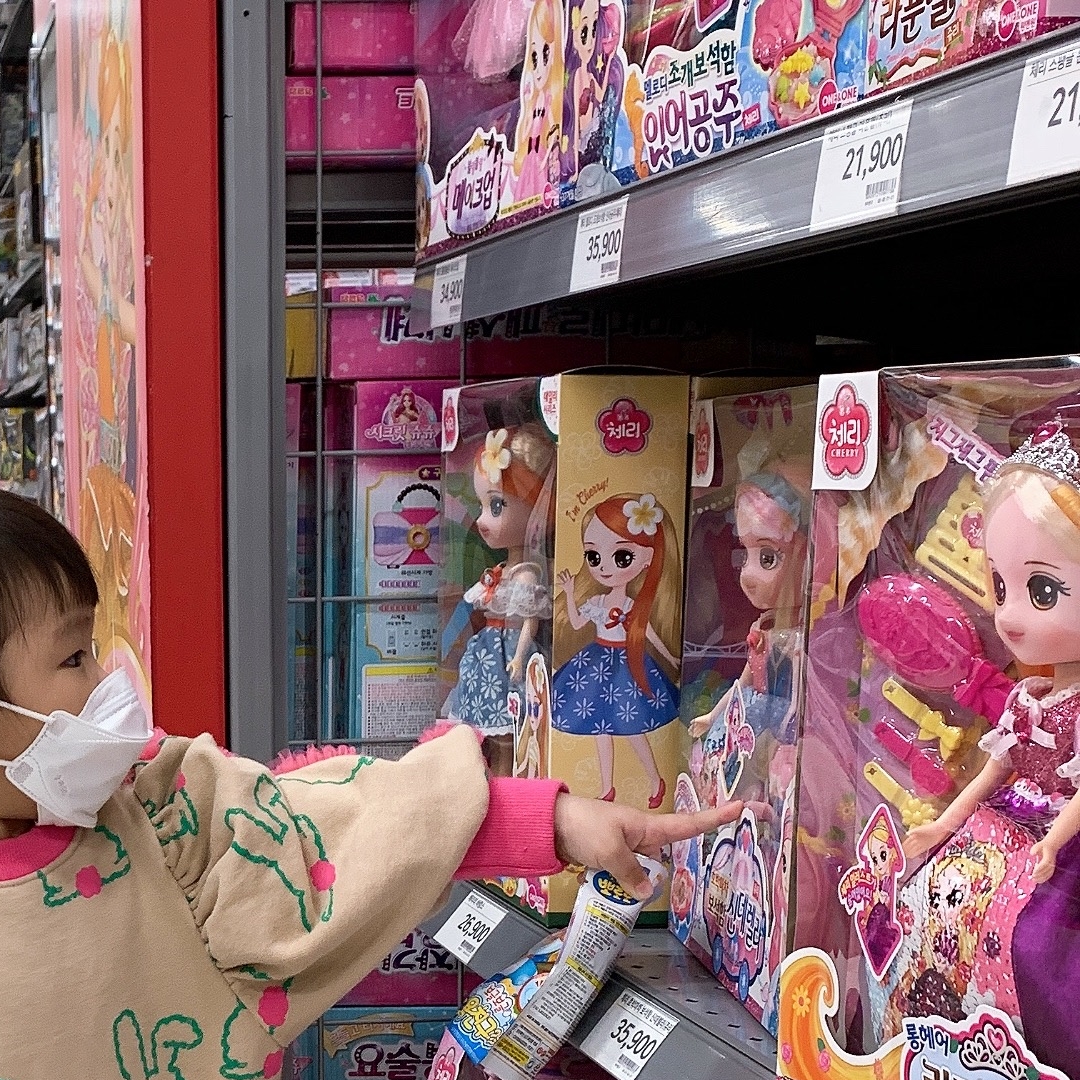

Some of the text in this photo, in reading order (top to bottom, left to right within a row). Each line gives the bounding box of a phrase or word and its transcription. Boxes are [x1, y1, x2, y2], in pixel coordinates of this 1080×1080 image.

[668, 40, 736, 92] 조개보석함
[841, 133, 903, 181] 21,900
[585, 229, 622, 262] 35,900
[607, 422, 641, 440] 체리
[828, 419, 862, 447] 체리
[830, 448, 860, 458] CHERRY
[457, 913, 491, 943] 26,900
[610, 1018, 658, 1061] 35,900
[906, 1024, 951, 1057] 롱헤어
